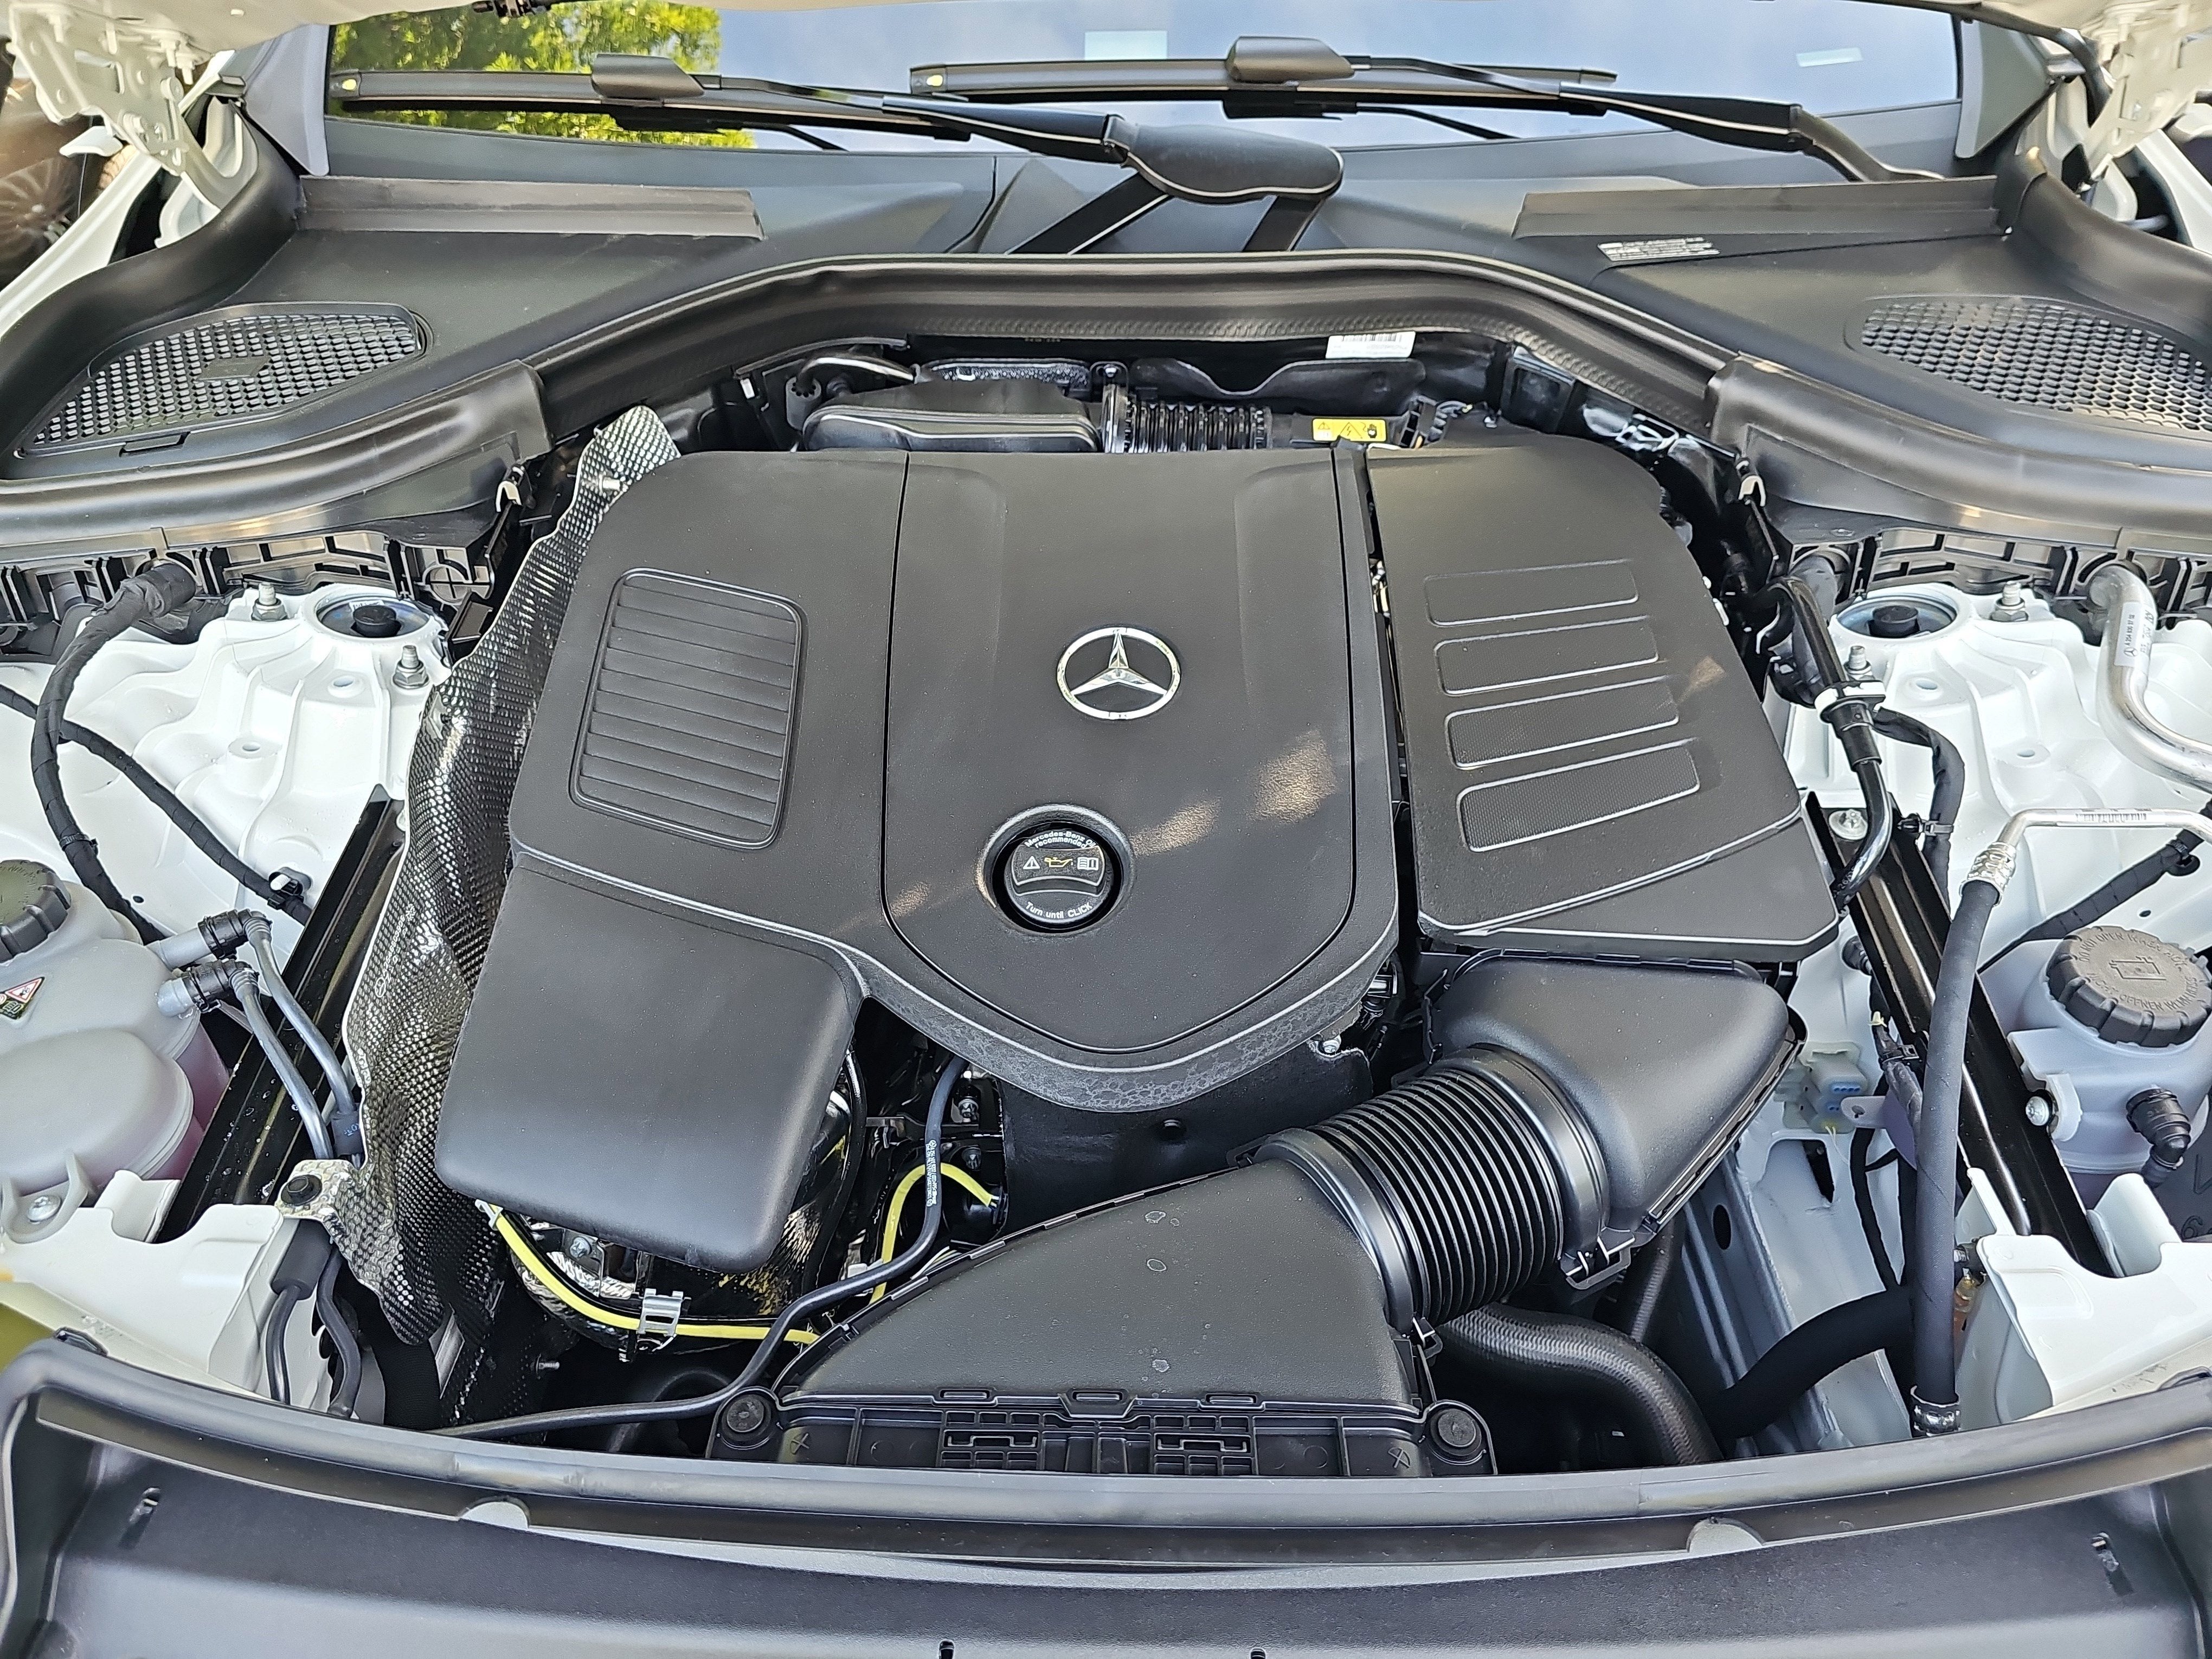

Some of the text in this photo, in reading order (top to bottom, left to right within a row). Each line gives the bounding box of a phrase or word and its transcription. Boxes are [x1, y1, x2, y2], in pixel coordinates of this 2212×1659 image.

[1024, 831, 1097, 847] Mercedes-Benz Oil
[1034, 837, 1088, 848] recommended
[1026, 902, 1094, 919] Turn until CLICK
[2096, 932, 2126, 942] OPEN
